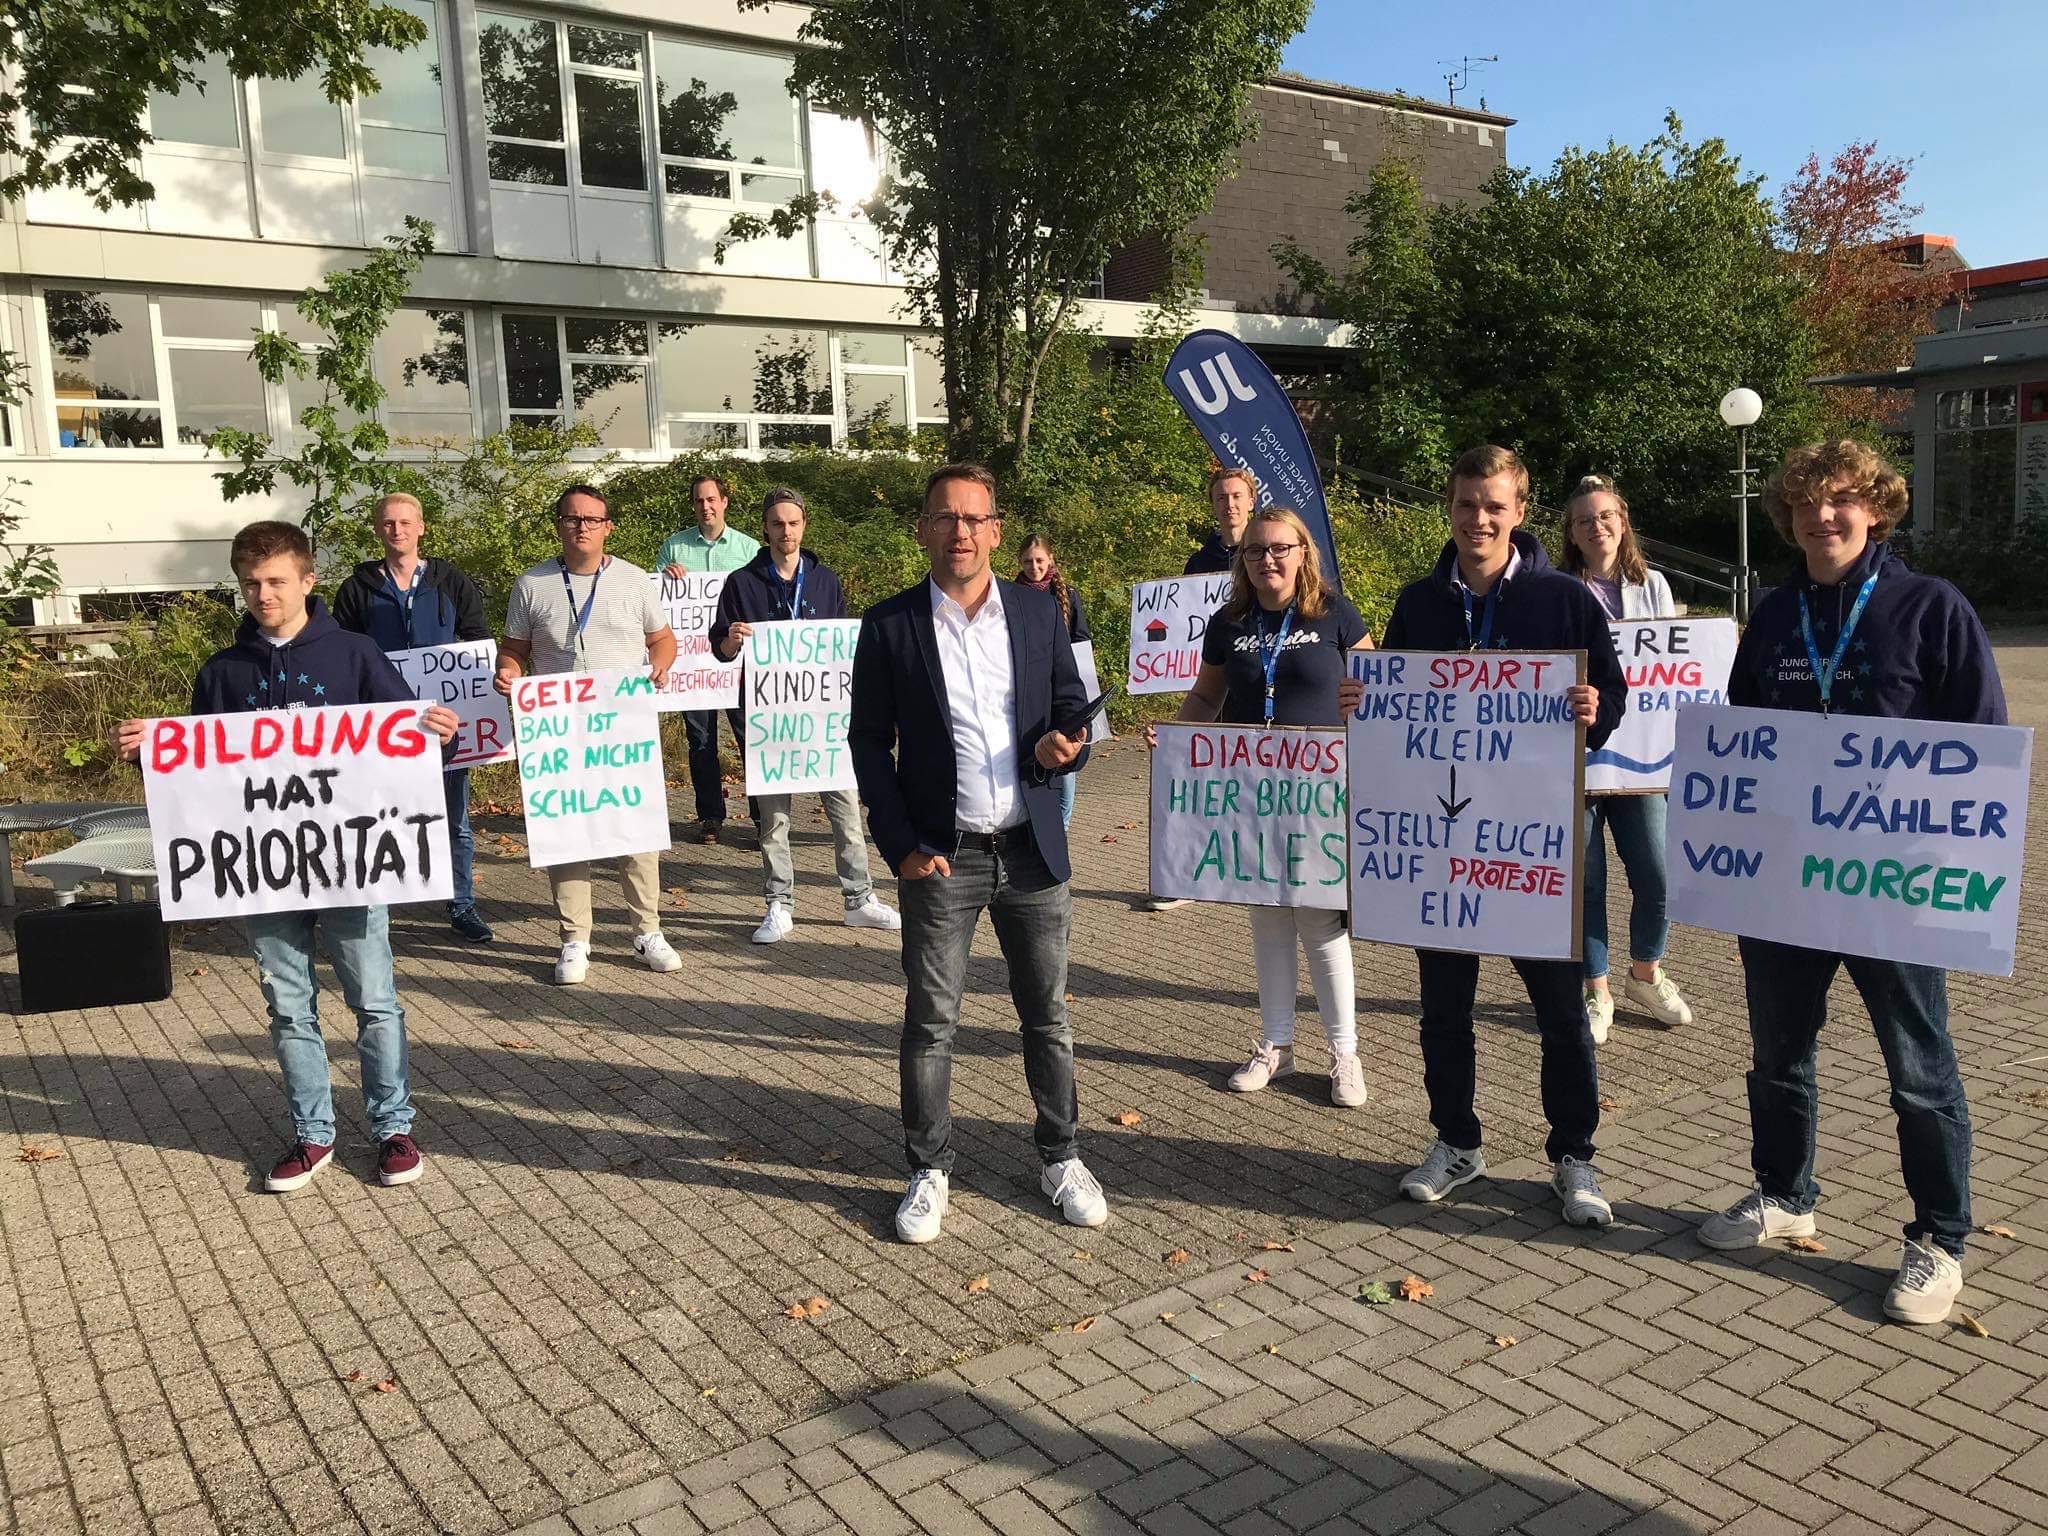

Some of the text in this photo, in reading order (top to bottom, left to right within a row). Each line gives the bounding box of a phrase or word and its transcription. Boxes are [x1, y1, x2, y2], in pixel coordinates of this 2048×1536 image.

[651, 576, 726, 602] NDLIC
[1137, 582, 1180, 613] WIR
[664, 604, 718, 631] LEBT
[422, 647, 491, 676] DOCH
[752, 626, 859, 666] UNSERE
[441, 677, 488, 703] DIE
[754, 671, 852, 707] KINDER
[1352, 655, 1553, 693] IHR SPART
[517, 675, 653, 713] GEIZ AM
[1354, 690, 1576, 725] UNSERE BILDUNG
[151, 708, 427, 775] BILDUNG
[519, 712, 618, 744] BAU IST
[750, 712, 814, 747] SIND
[1406, 723, 1514, 762] KLEIN
[521, 740, 656, 780] GAR NICHT
[760, 748, 842, 784] WERT
[1189, 733, 1345, 775] DIAGNOS
[1707, 724, 1979, 776] WIR SIND
[244, 768, 341, 813] HAT
[528, 784, 642, 818] SCHLAU
[1169, 775, 1347, 819] HIER BRÖCK
[1683, 772, 2008, 839] DIE WÄHLER
[1354, 807, 1566, 860] STELLT EUCH
[168, 806, 445, 903] PRIORITÄT
[1193, 829, 1346, 888] ALLES
[1360, 851, 1568, 898] AUF PROTESTE
[1682, 839, 2007, 913] VON MORGEN
[1421, 890, 1482, 929] EIN
